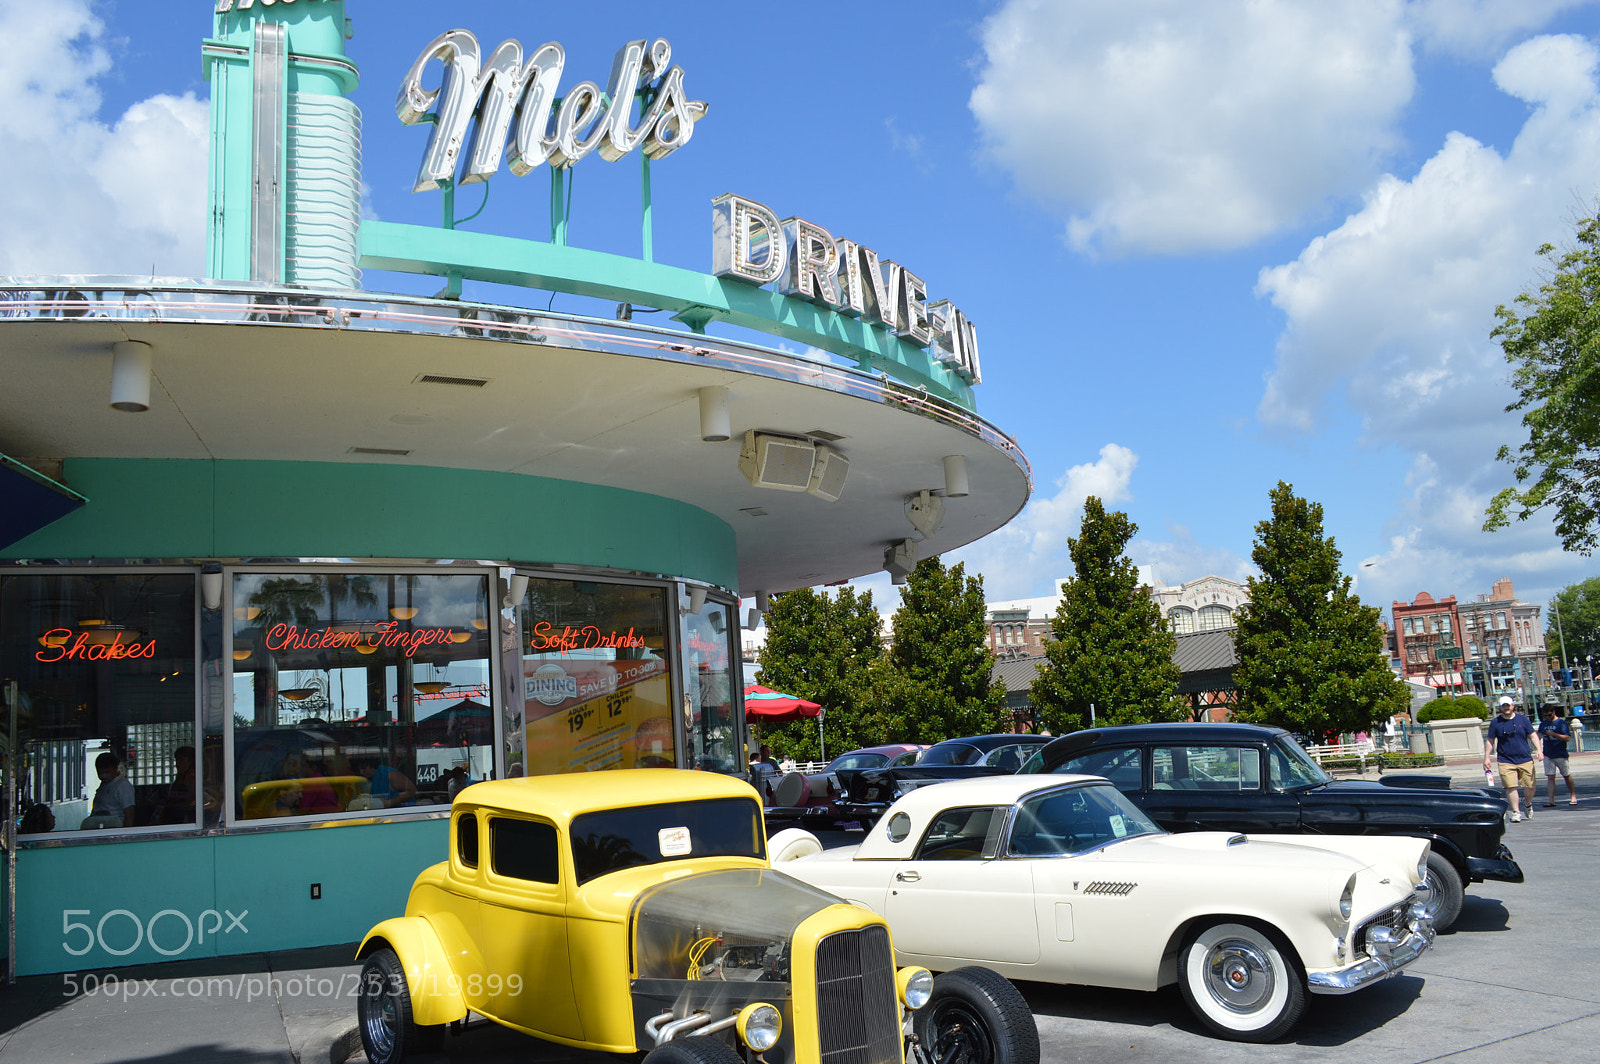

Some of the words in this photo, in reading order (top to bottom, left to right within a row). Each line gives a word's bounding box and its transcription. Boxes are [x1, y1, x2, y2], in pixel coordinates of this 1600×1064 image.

[397, 28, 708, 193] Mel's
[35, 628, 156, 662] Shakes
[265, 622, 362, 650] Chicken
[366, 620, 455, 658] Fingers
[530, 621, 579, 656] Soft
[580, 625, 645, 651] Drinks
[526, 678, 576, 693] DINING
[580, 678, 607, 696] SAVE
[608, 673, 623, 685] UP
[625, 667, 638, 679] TO
[639, 661, 657, 674] 30%
[568, 704, 588, 716] ADULT
[606, 691, 625, 702] CHILD
